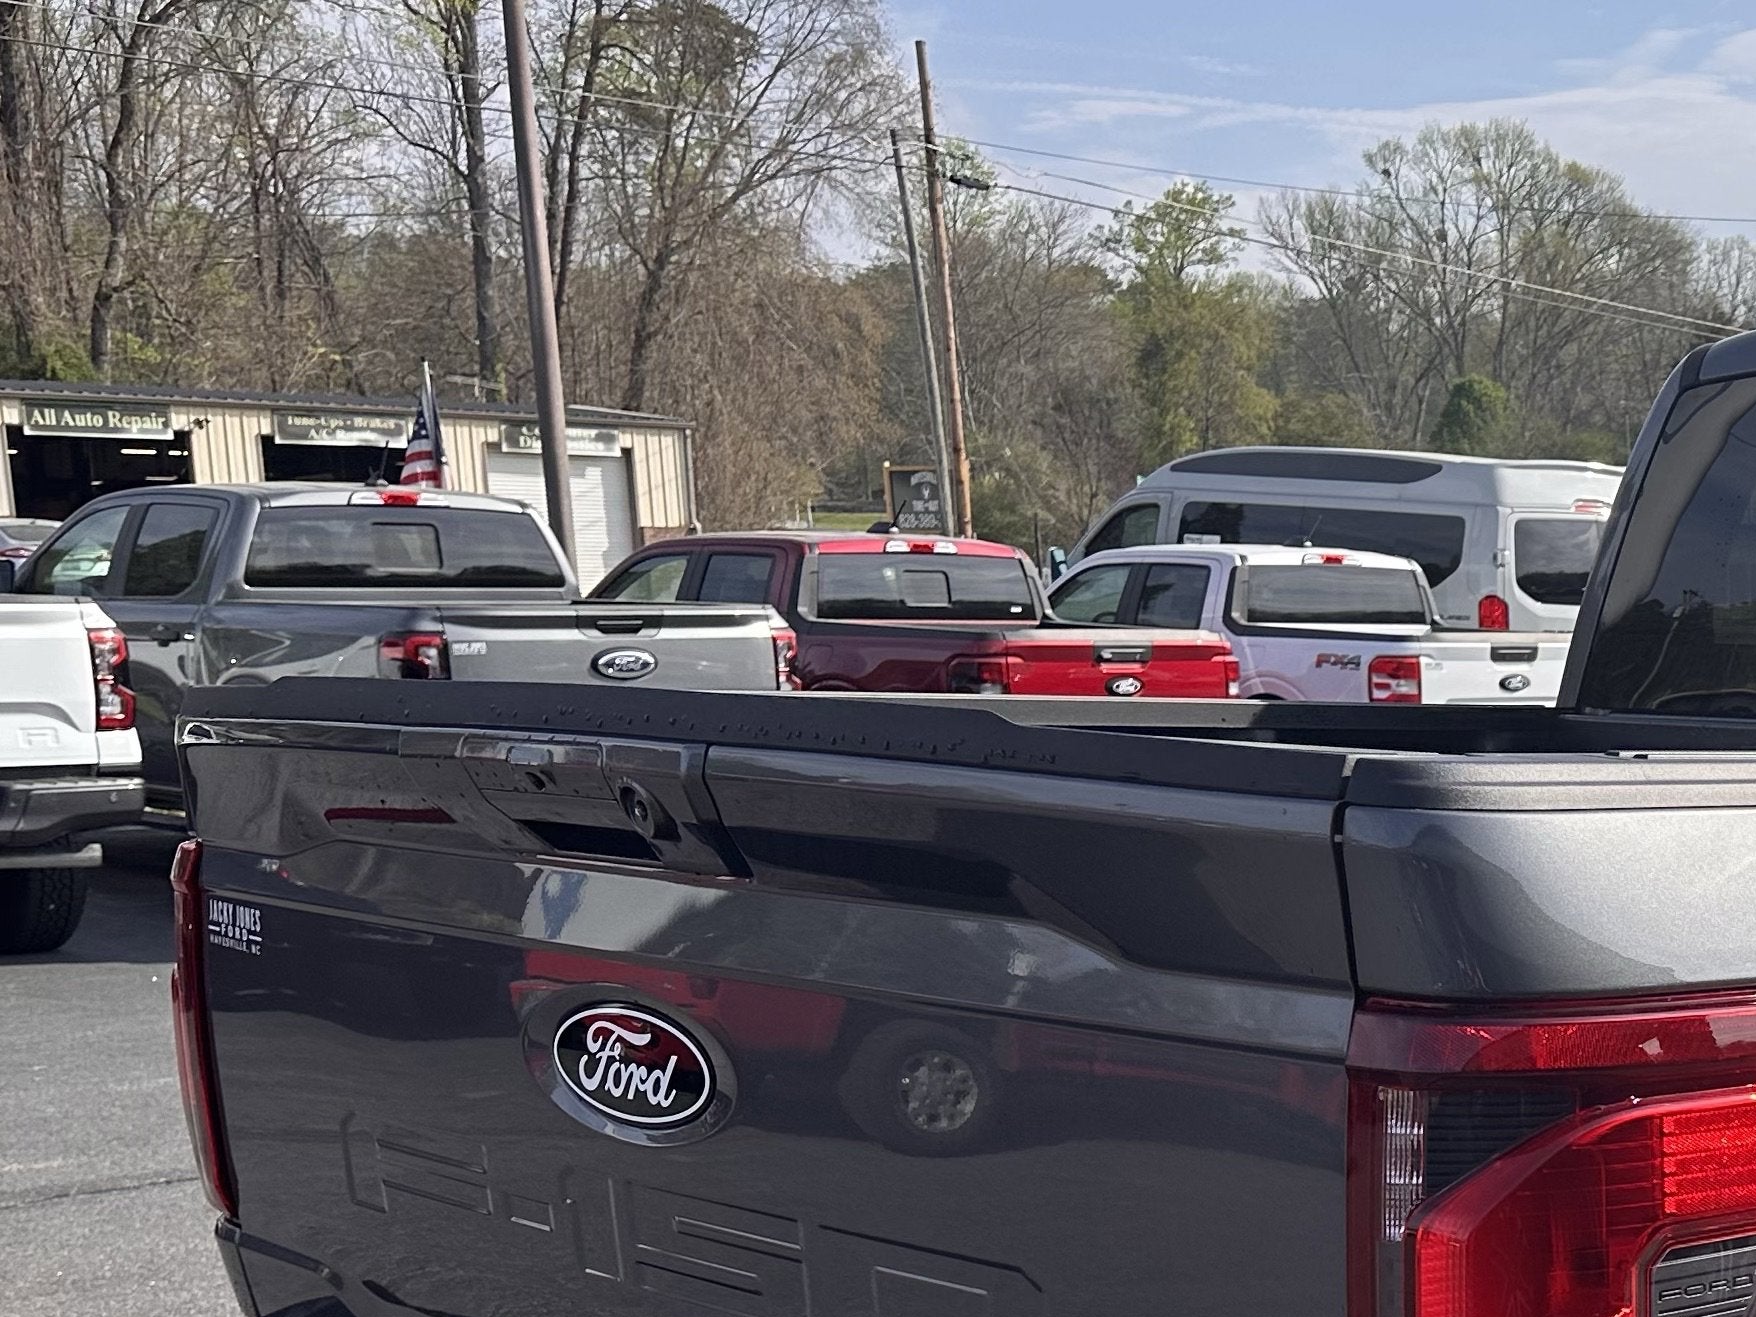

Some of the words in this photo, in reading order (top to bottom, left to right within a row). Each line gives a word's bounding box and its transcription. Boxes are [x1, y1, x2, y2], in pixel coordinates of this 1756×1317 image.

[30, 407, 57, 426] All
[60, 409, 104, 428] Auto
[107, 410, 166, 433] Repair
[208, 898, 234, 925] JACKY
[235, 904, 261, 933] JONES
[221, 923, 248, 941] FORD
[578, 1019, 678, 1109] Ford
[1657, 1275, 1755, 1304] FORD
